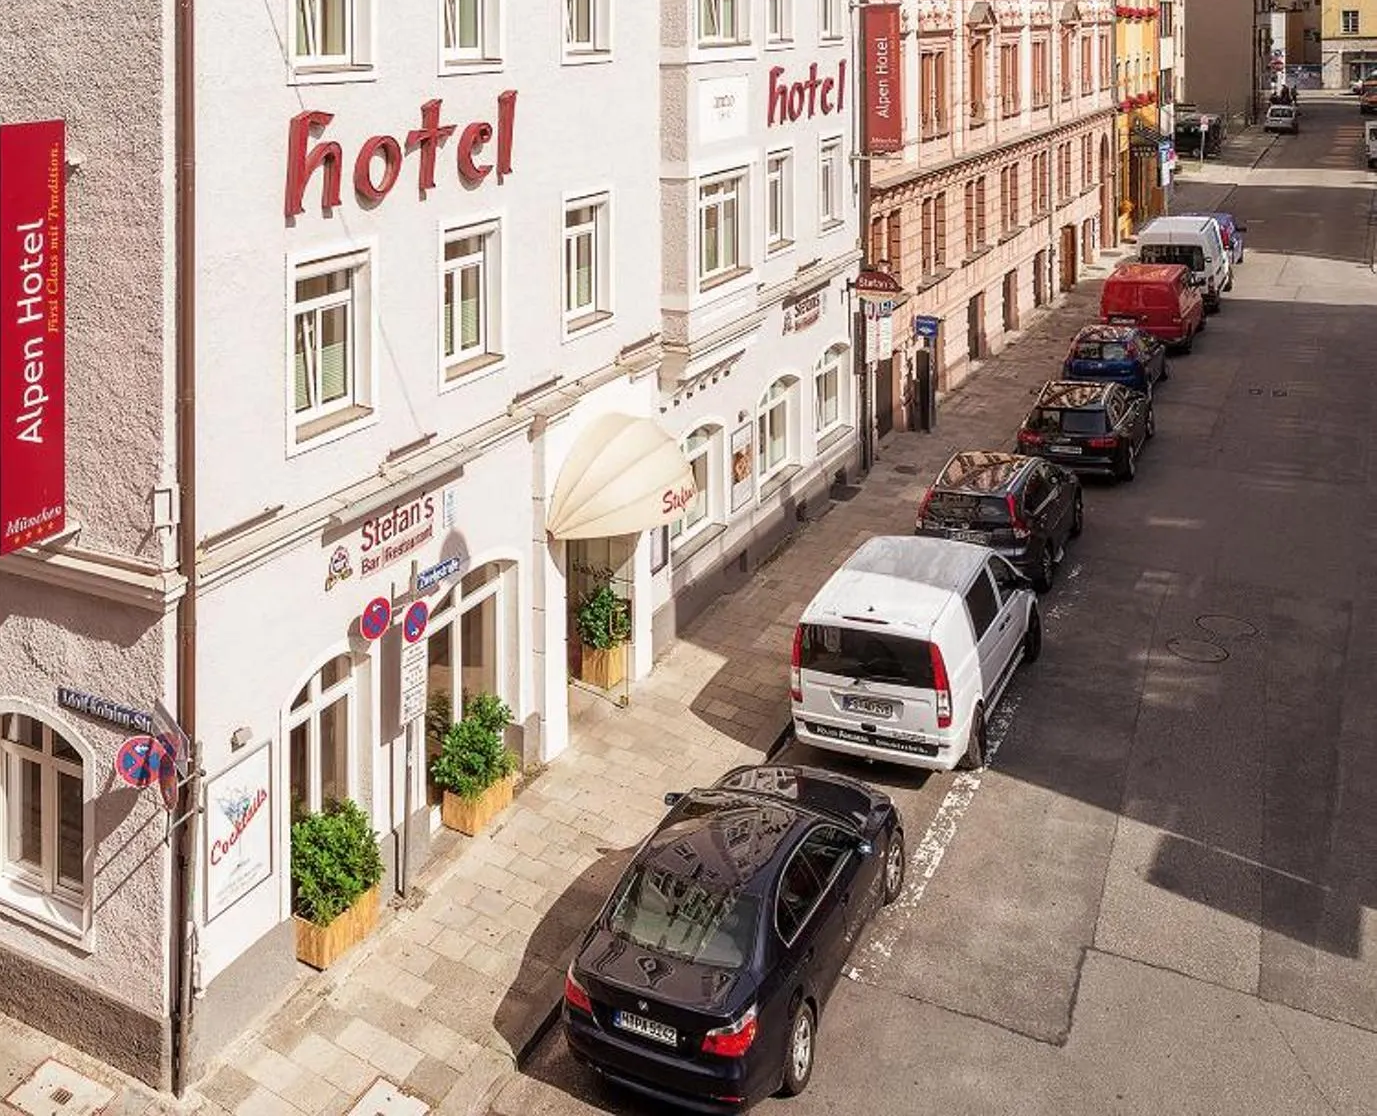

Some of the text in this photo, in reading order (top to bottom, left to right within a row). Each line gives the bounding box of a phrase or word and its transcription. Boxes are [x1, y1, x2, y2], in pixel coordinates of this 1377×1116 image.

[767, 58, 847, 127] hotel
[875, 37, 891, 118] Alpen Hotel
[285, 90, 517, 216] hotel
[47, 224, 59, 250] mit
[46, 255, 59, 295] Class
[16, 218, 49, 444] Alpen Hotel
[47, 299, 59, 333] First
[361, 492, 435, 552] Stefan's
[361, 554, 381, 575] Bar
[210, 788, 267, 866] Cocktails
